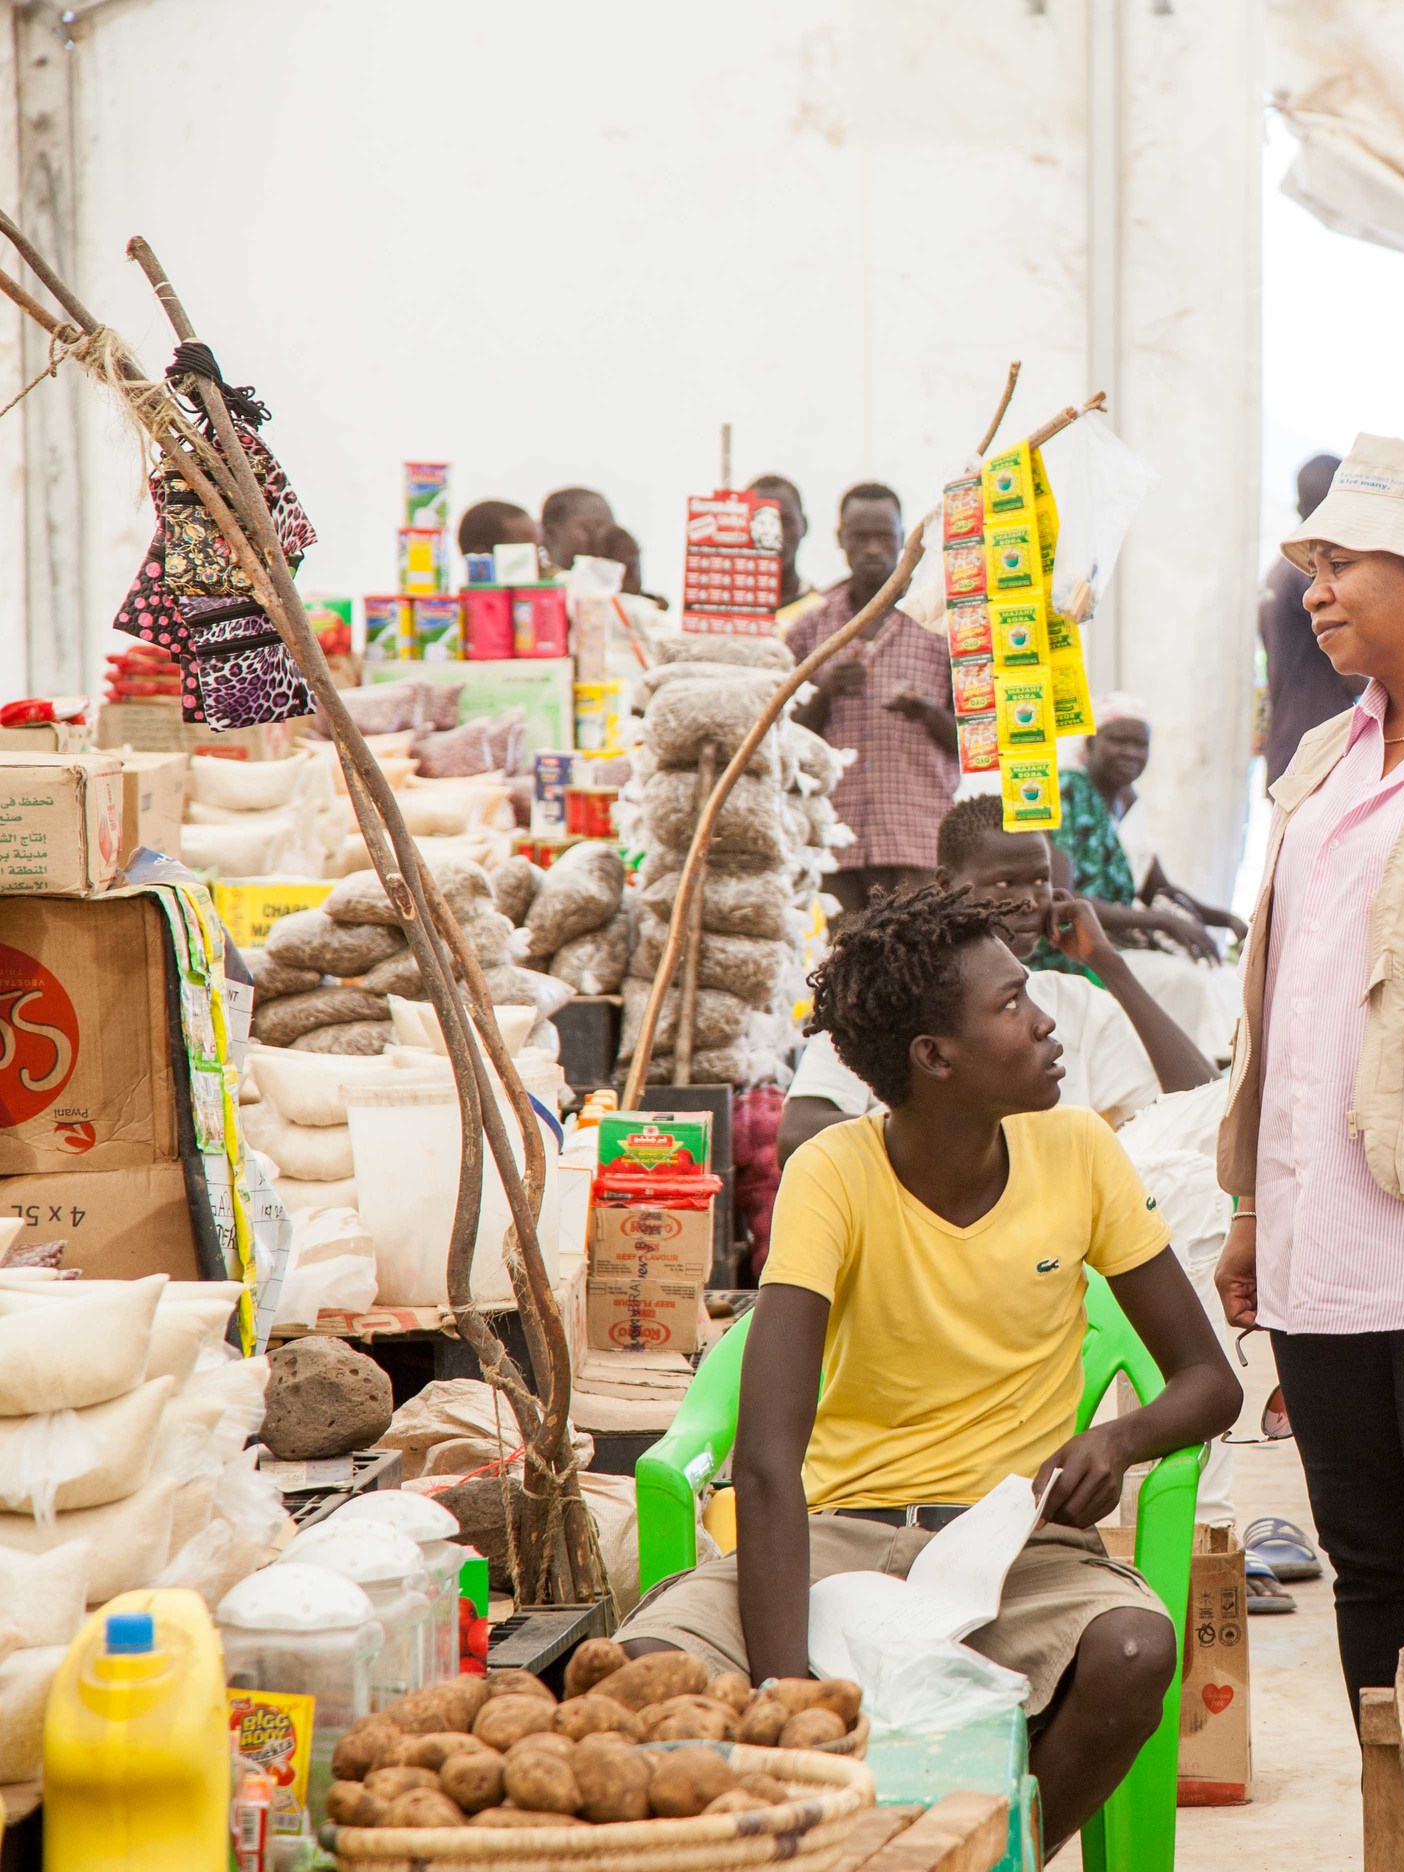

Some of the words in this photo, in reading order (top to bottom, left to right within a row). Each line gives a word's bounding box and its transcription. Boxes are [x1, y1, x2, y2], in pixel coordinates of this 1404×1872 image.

[1360, 480, 1391, 490] many.
[1007, 686, 1040, 695] MAJANI
[0, 881, 48, 893] الإسكندر
[54, 1108, 88, 1119] Pwani
[11, 1205, 40, 1227] 5L
[48, 1205, 62, 1223] x
[70, 1206, 86, 1228] 4
[613, 1299, 652, 1308] FLAOUR
[654, 1300, 676, 1308] BEEF
